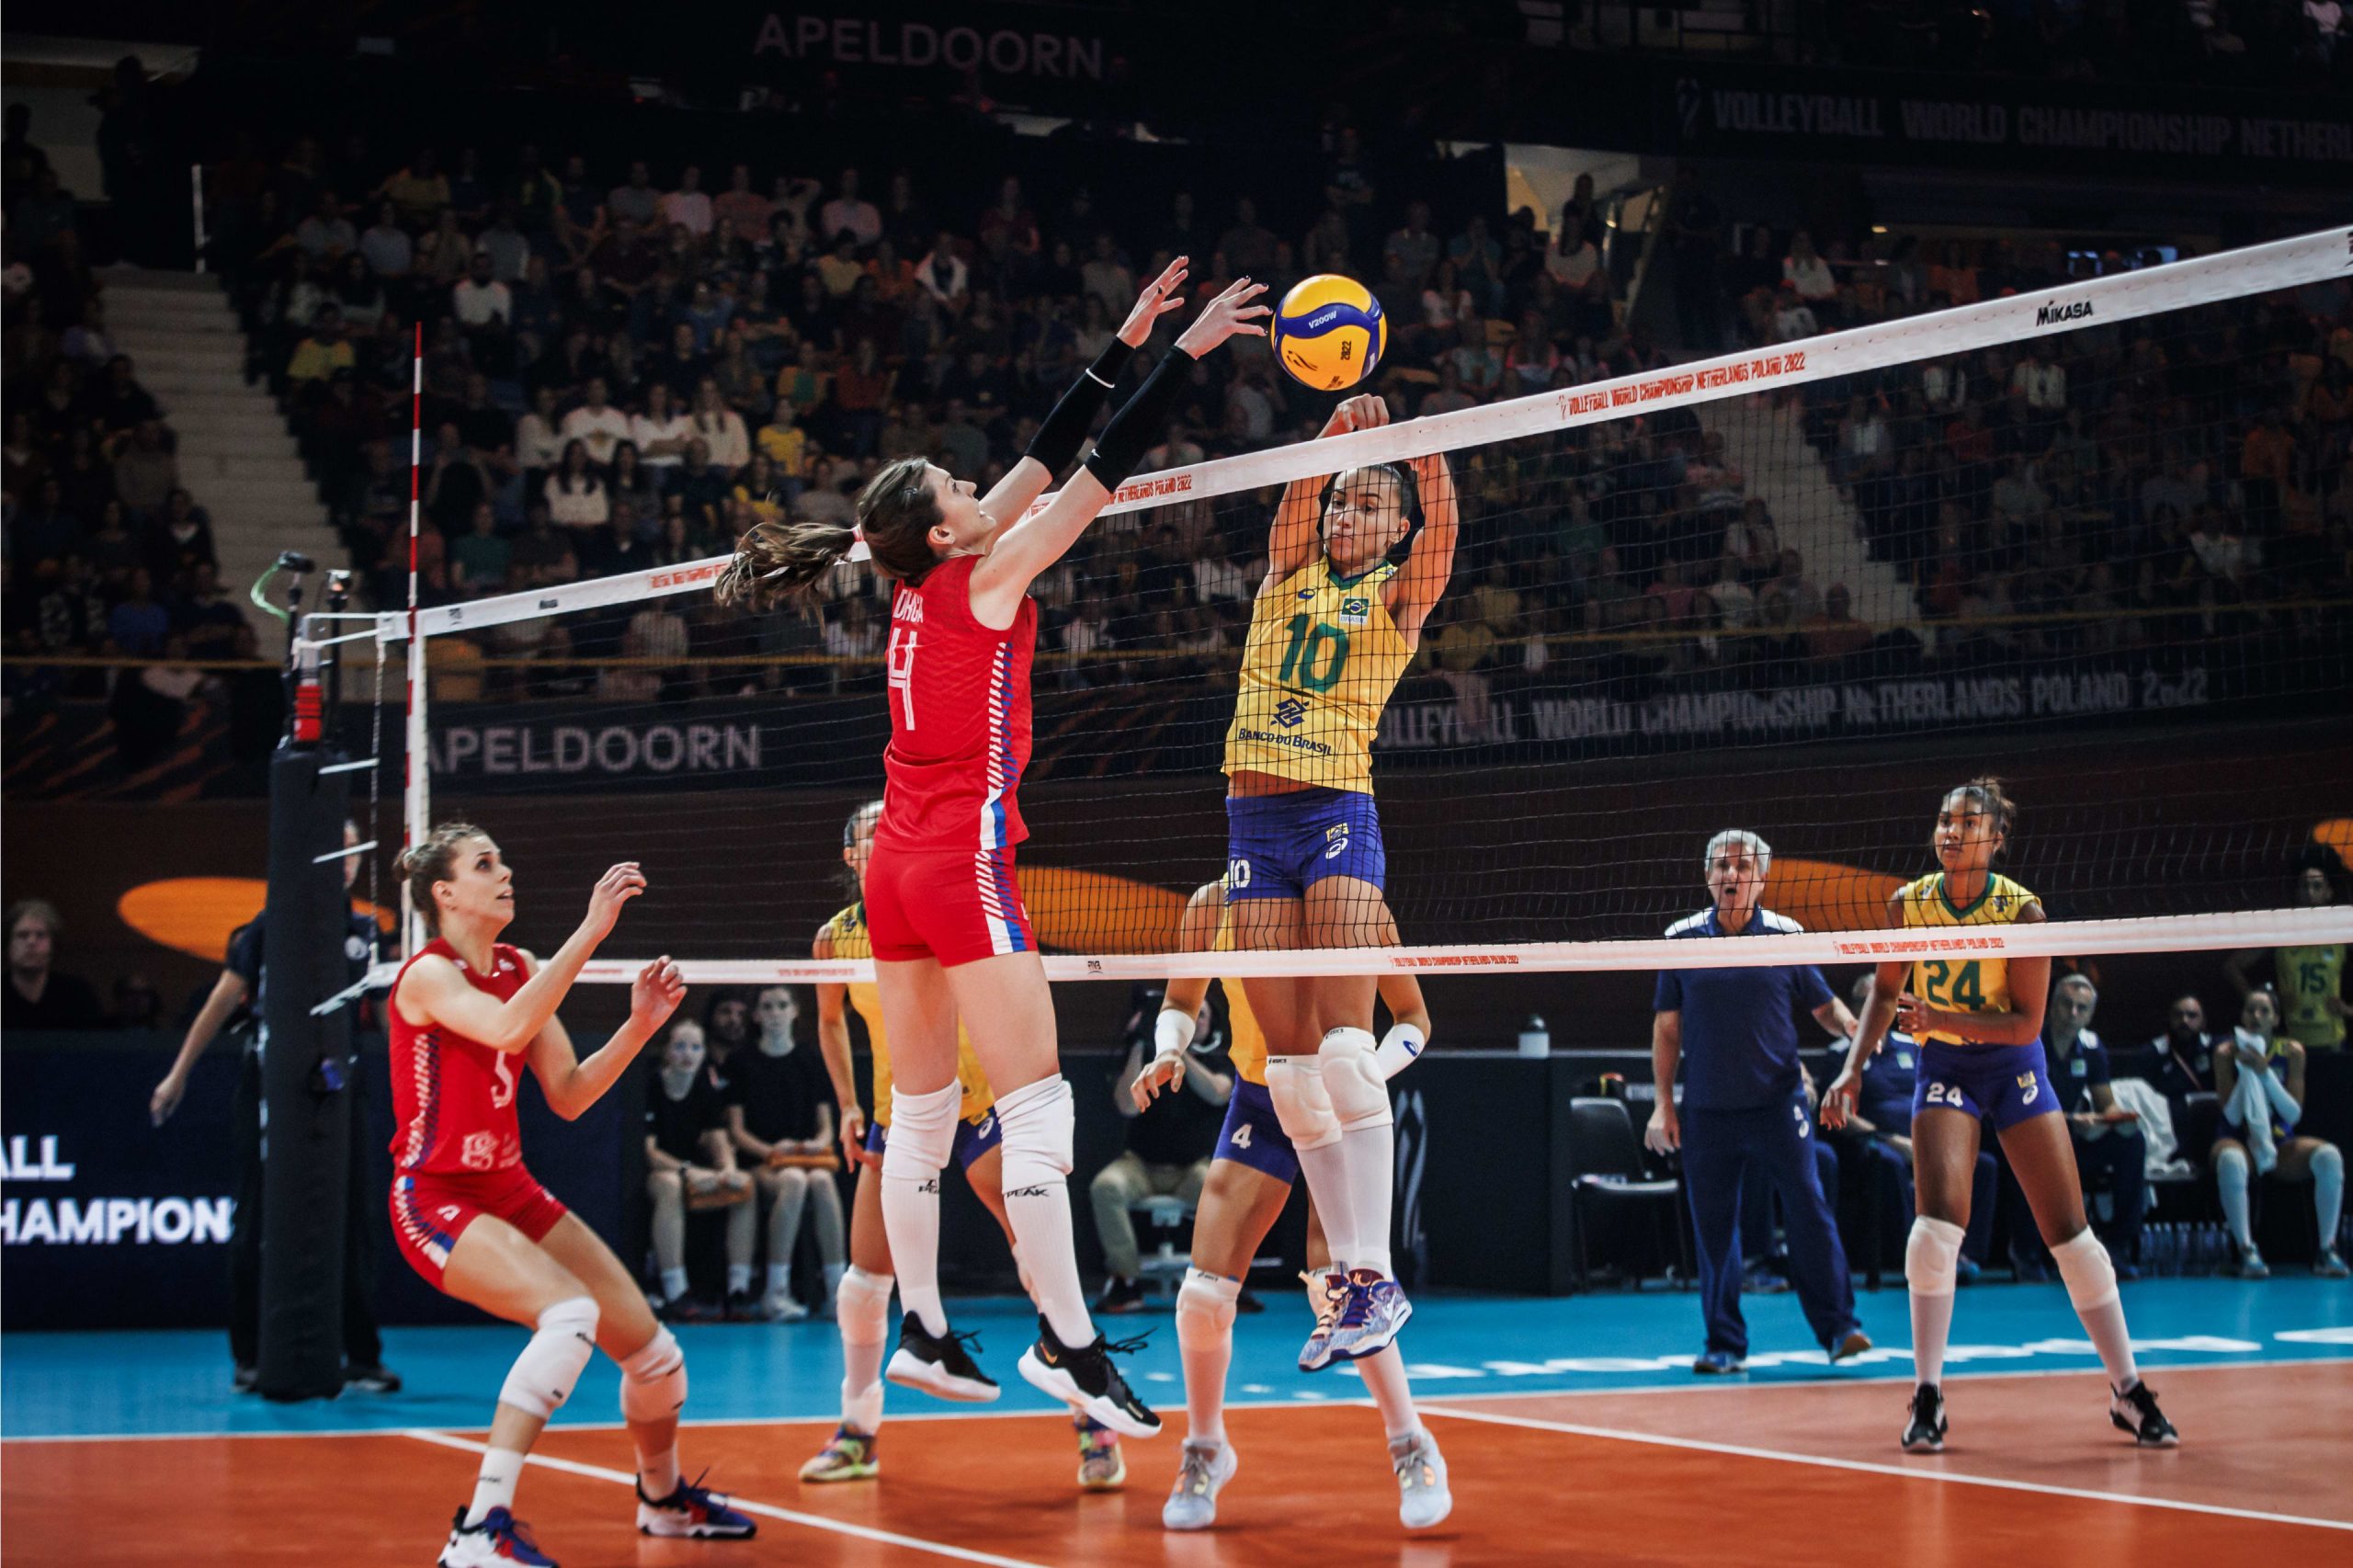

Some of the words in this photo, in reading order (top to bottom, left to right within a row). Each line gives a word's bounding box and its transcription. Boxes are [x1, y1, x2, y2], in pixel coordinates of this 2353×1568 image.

[754, 14, 1101, 79] APELDOORN
[1712, 89, 1884, 138] VOLLEYBALL
[1899, 97, 2007, 143] WORLD
[2018, 104, 2234, 155] CHAMPIONSHIP
[1308, 310, 1337, 329] V200W
[1568, 391, 1608, 415] VOLLEYBALL
[1610, 385, 1638, 406] WORLD
[1640, 374, 1694, 402] CHAMPIONSHIP
[1696, 364, 1749, 390] NETHERLANDS
[1751, 357, 1781, 380] POLAND
[1784, 351, 1805, 372] 2022
[1278, 612, 1349, 693] 10
[888, 628, 917, 731] 4
[1381, 700, 1517, 747] OLLEYLL
[2031, 671, 2130, 714] POLAND
[1230, 859, 1251, 889] 10
[1924, 960, 1985, 1010] 24
[2300, 962, 2326, 993] 15
[490, 1050, 513, 1109] 5
[1927, 1082, 1963, 1107] 24
[0, 1134, 75, 1181] LL
[1231, 1123, 1253, 1149] 4
[1006, 1187, 1049, 1198] PEAK
[0, 1197, 237, 1244] HAMPION
